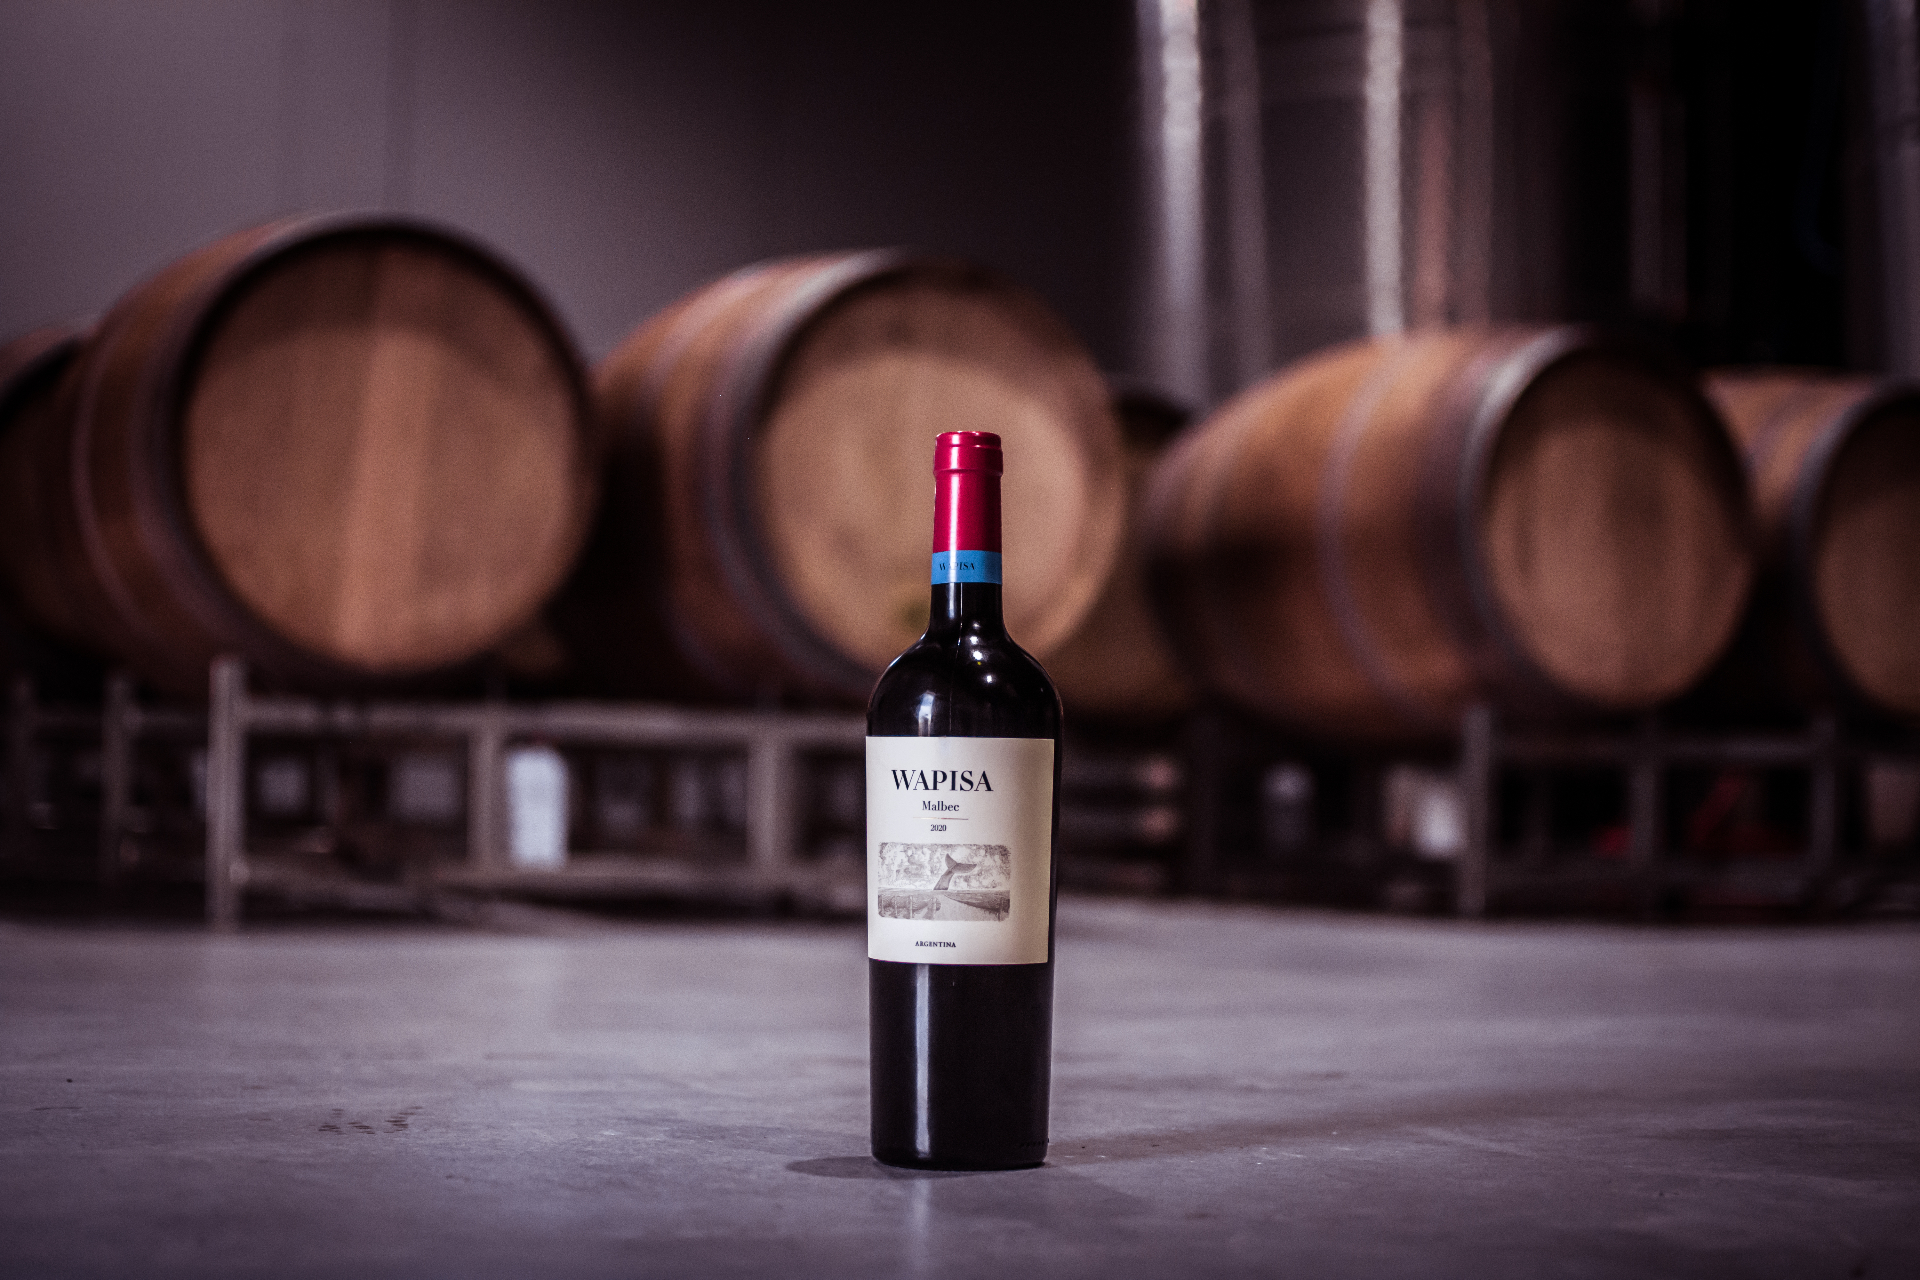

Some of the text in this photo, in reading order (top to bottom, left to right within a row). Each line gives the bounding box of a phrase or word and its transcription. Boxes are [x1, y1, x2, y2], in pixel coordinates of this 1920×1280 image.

[939, 562, 975, 571] WPISA
[891, 770, 994, 792] WAPISA
[922, 801, 960, 811] Malbec
[930, 824, 947, 832] 2020
[915, 940, 956, 948] ARGENTINA
